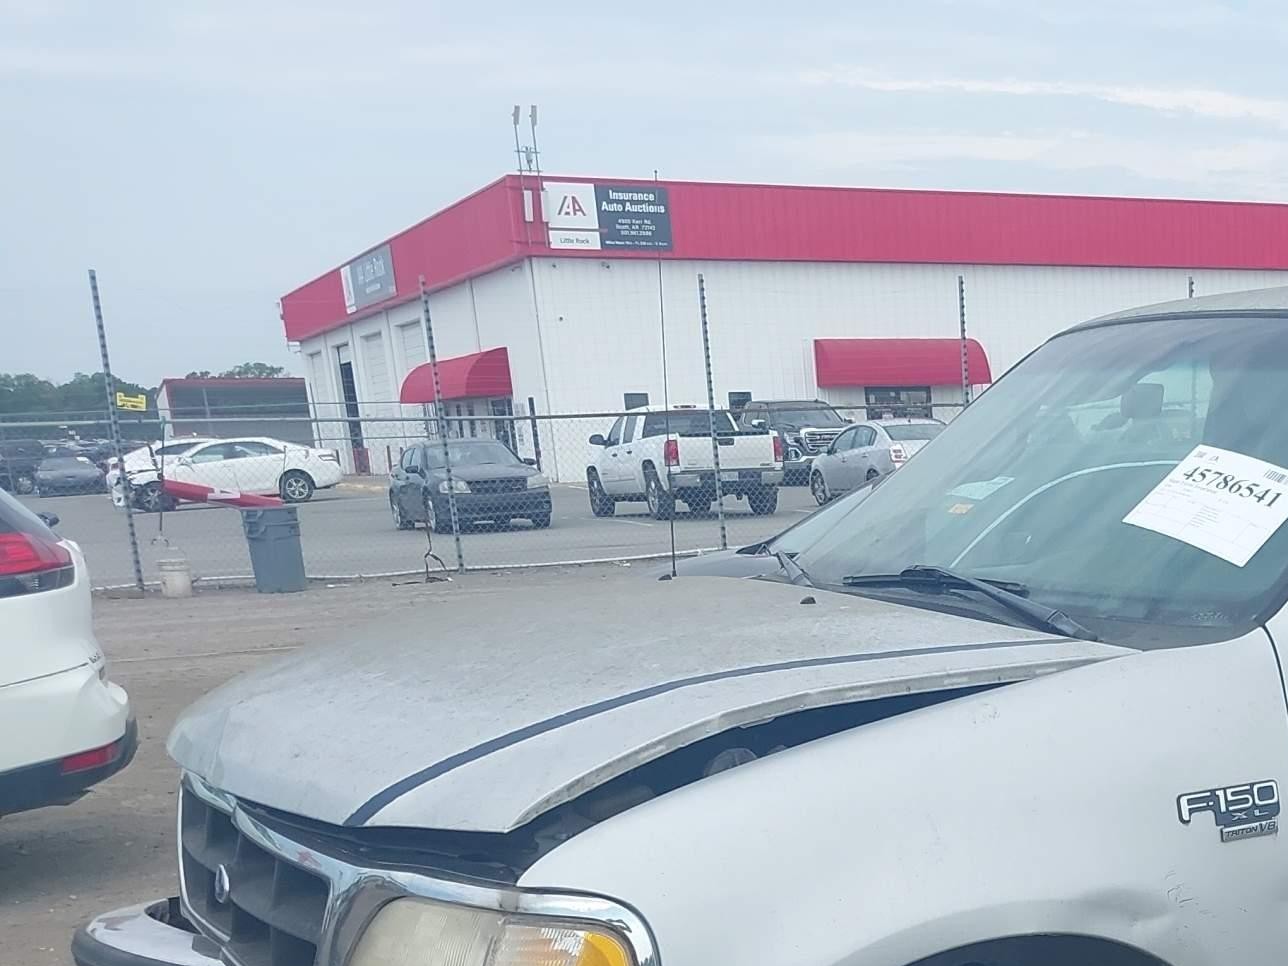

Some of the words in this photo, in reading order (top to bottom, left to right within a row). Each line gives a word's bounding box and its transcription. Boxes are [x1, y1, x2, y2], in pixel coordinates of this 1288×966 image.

[609, 189, 655, 202] Insurance
[601, 201, 624, 213] Auto
[625, 202, 666, 214] Auctions
[1183, 466, 1283, 508] 45786541
[1179, 780, 1279, 822] F-150
[1231, 809, 1269, 821] XL
[1225, 825, 1258, 838] TRITON
[1259, 820, 1277, 833] V8
